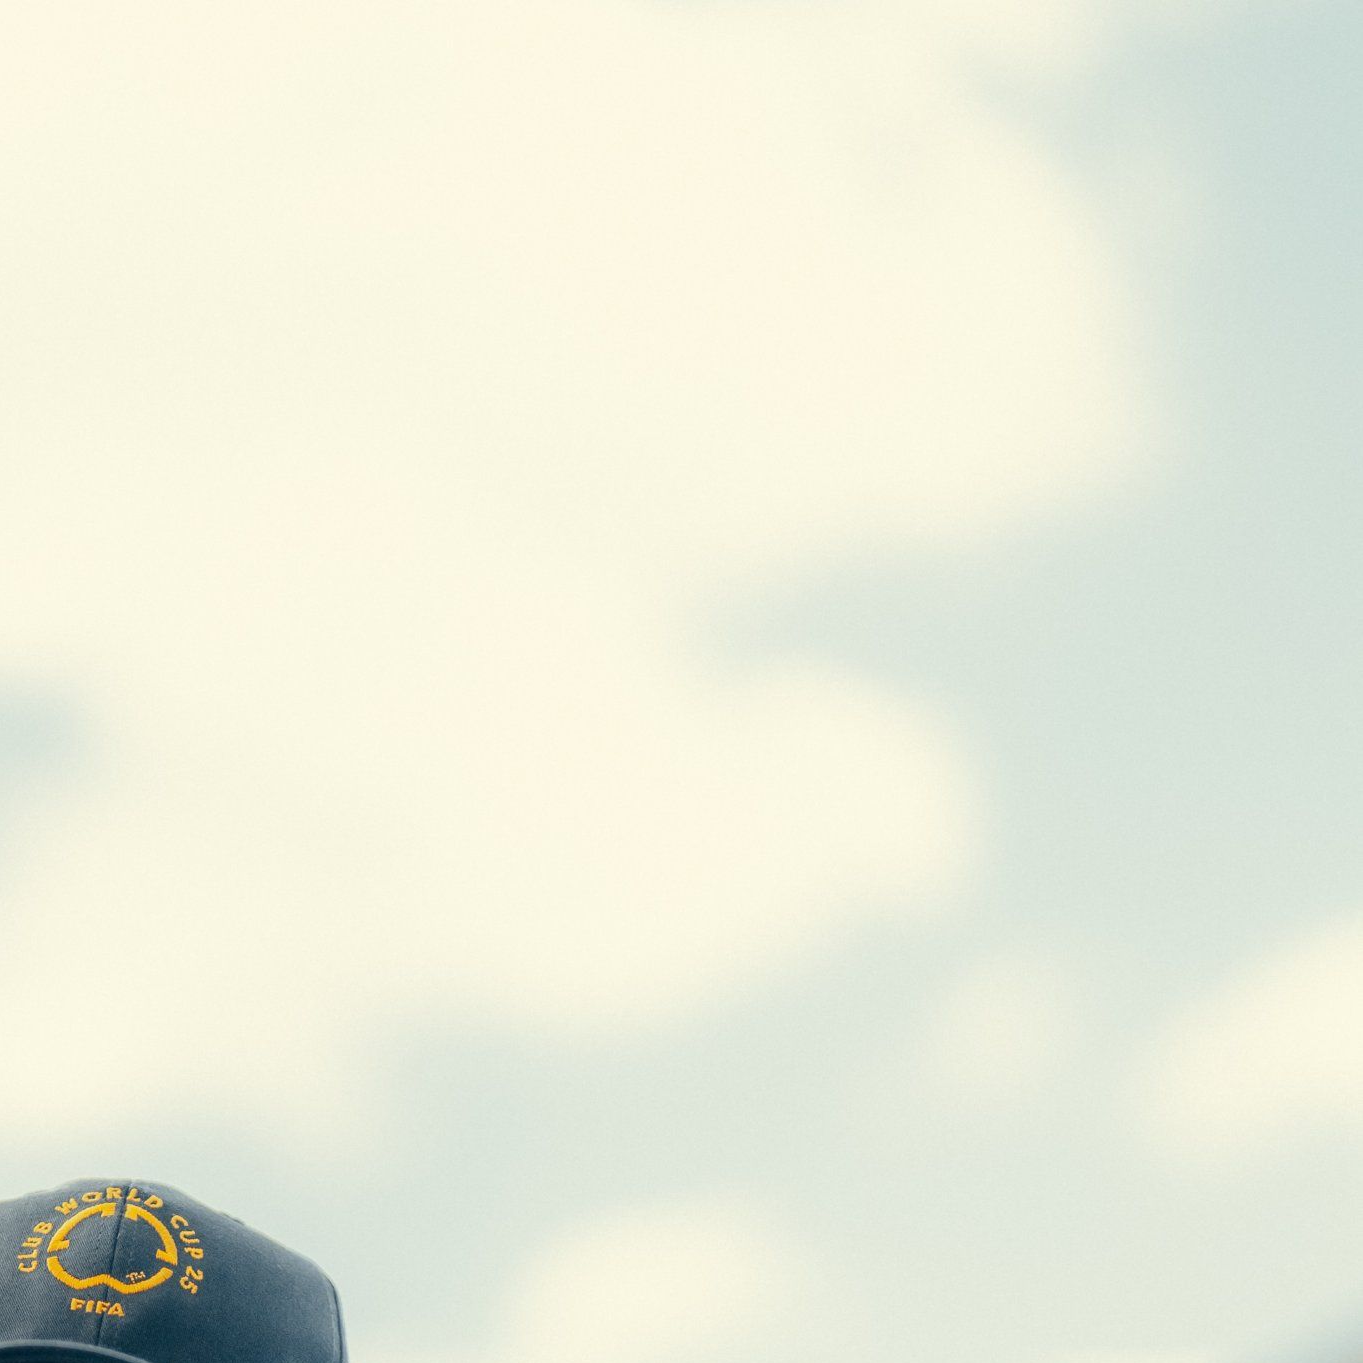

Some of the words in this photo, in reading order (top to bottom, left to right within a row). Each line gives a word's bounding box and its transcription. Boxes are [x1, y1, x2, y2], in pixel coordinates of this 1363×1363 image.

[54, 1186, 164, 1216] WORLD
[17, 1221, 54, 1273] CLUB
[170, 1213, 204, 1259] CUP
[179, 1265, 204, 1294] 25
[70, 1297, 125, 1317] FIFA
